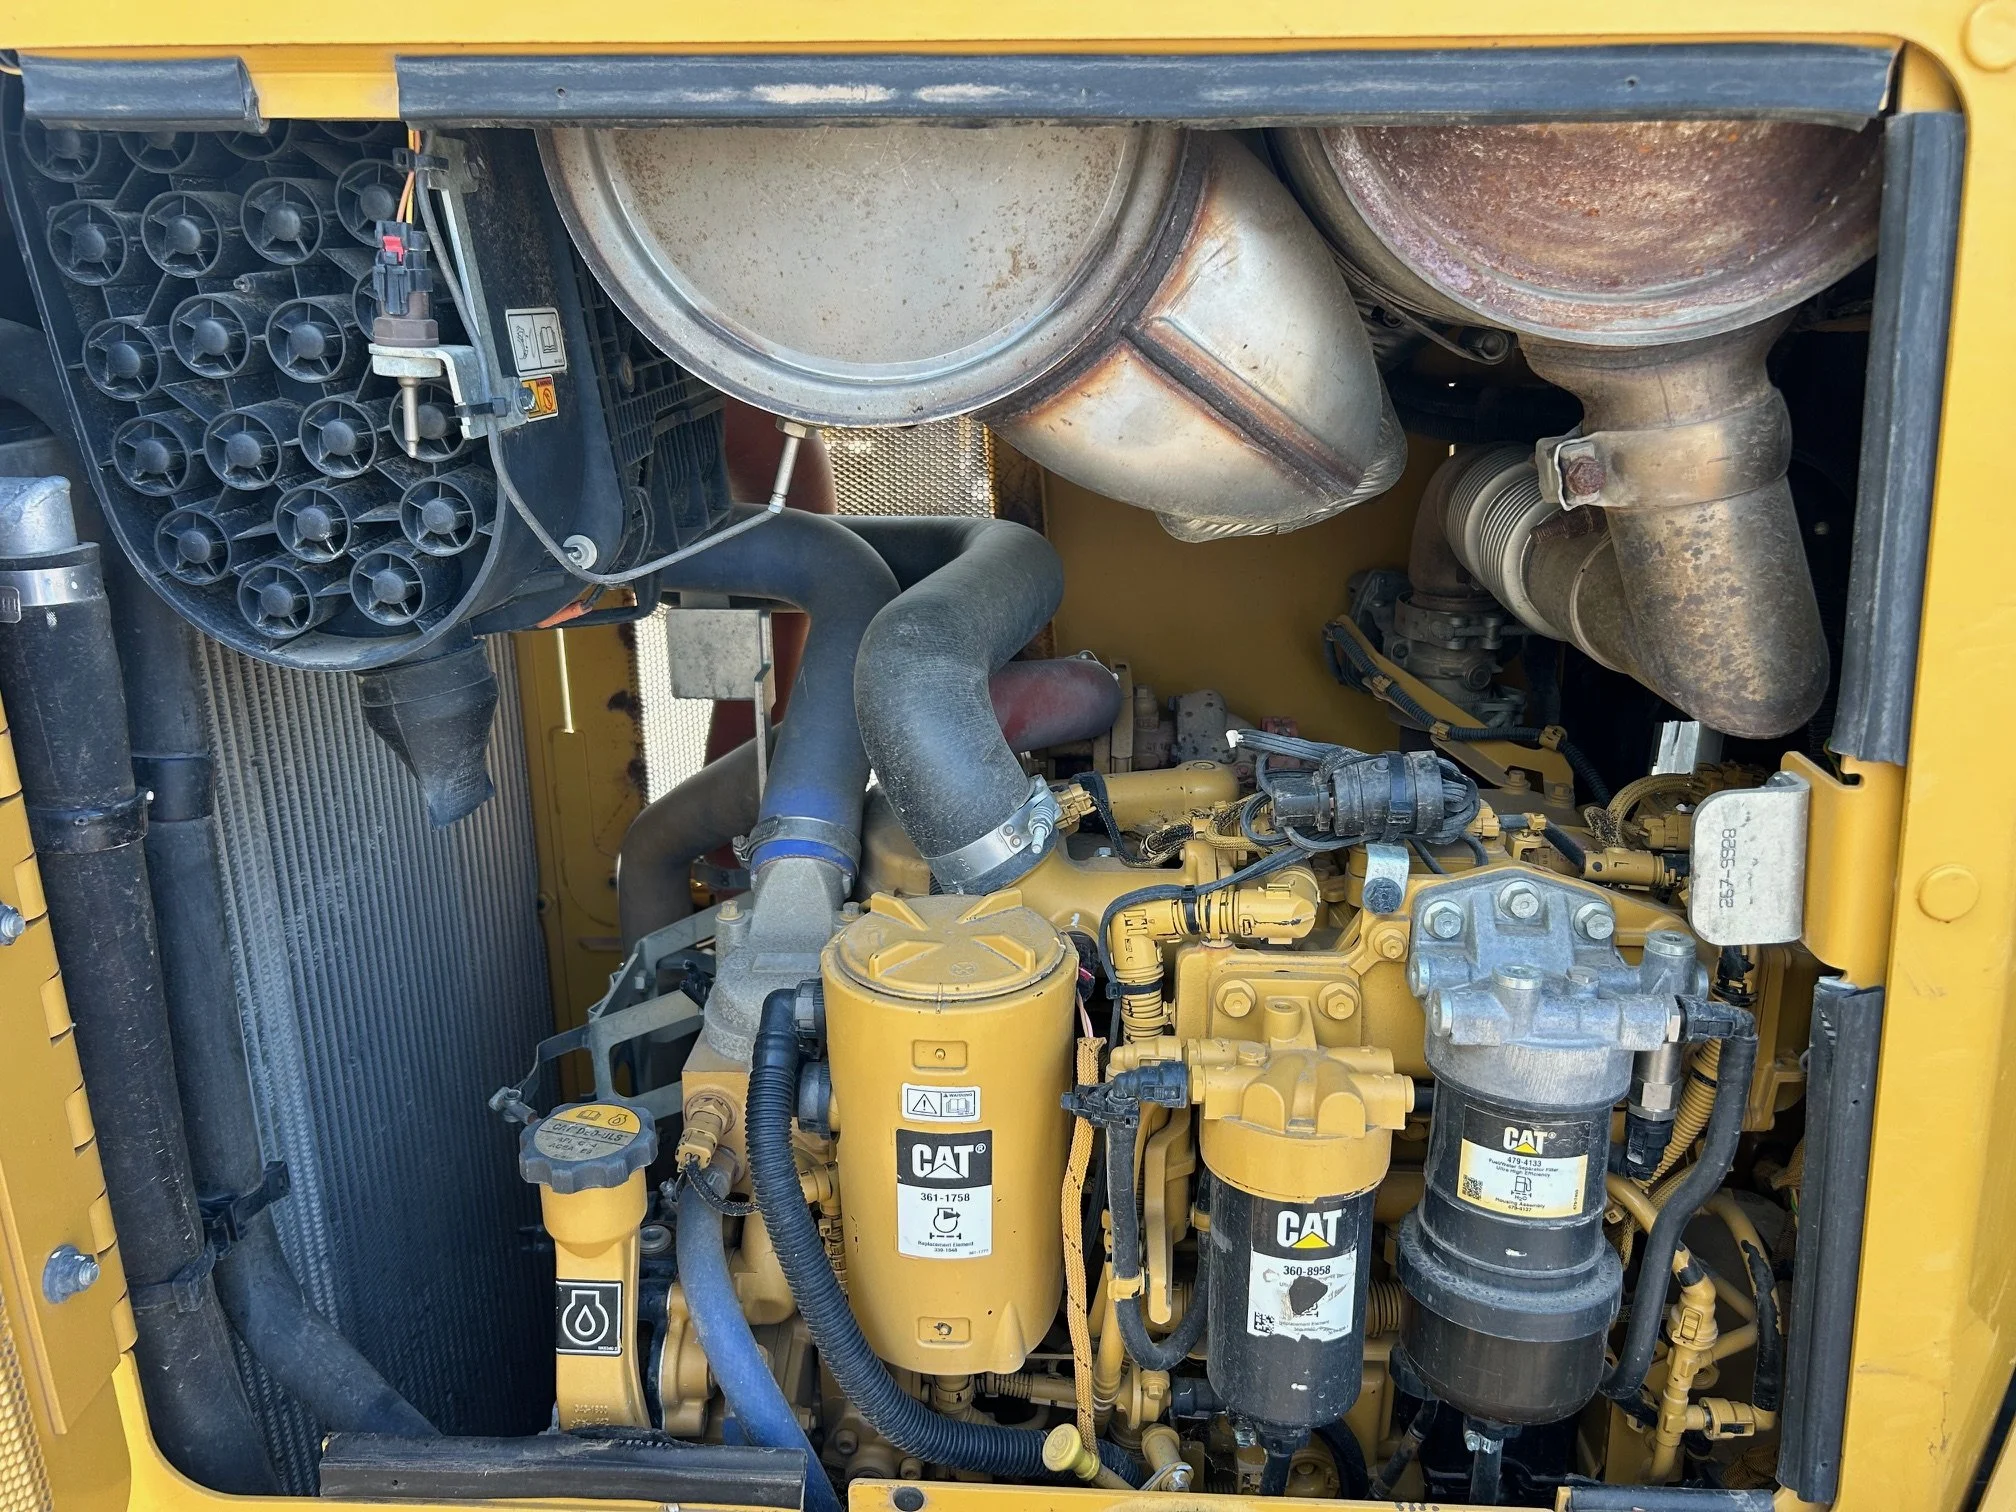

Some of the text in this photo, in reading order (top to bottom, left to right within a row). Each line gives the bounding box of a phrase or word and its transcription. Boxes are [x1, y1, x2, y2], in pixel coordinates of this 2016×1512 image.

[1719, 828, 1737, 909] 267-9928
[1503, 1127, 1548, 1155] CAT
[911, 1143, 974, 1179] CAT
[1507, 1156, 1542, 1167] 479-4133
[1524, 1170, 1550, 1178] Efficiency
[920, 1192, 971, 1203] 361-1758
[1495, 1197, 1518, 1206] Housing
[1276, 1208, 1342, 1248] CAT
[917, 1240, 952, 1248] Replacement
[1283, 1265, 1331, 1276] 360-8958
